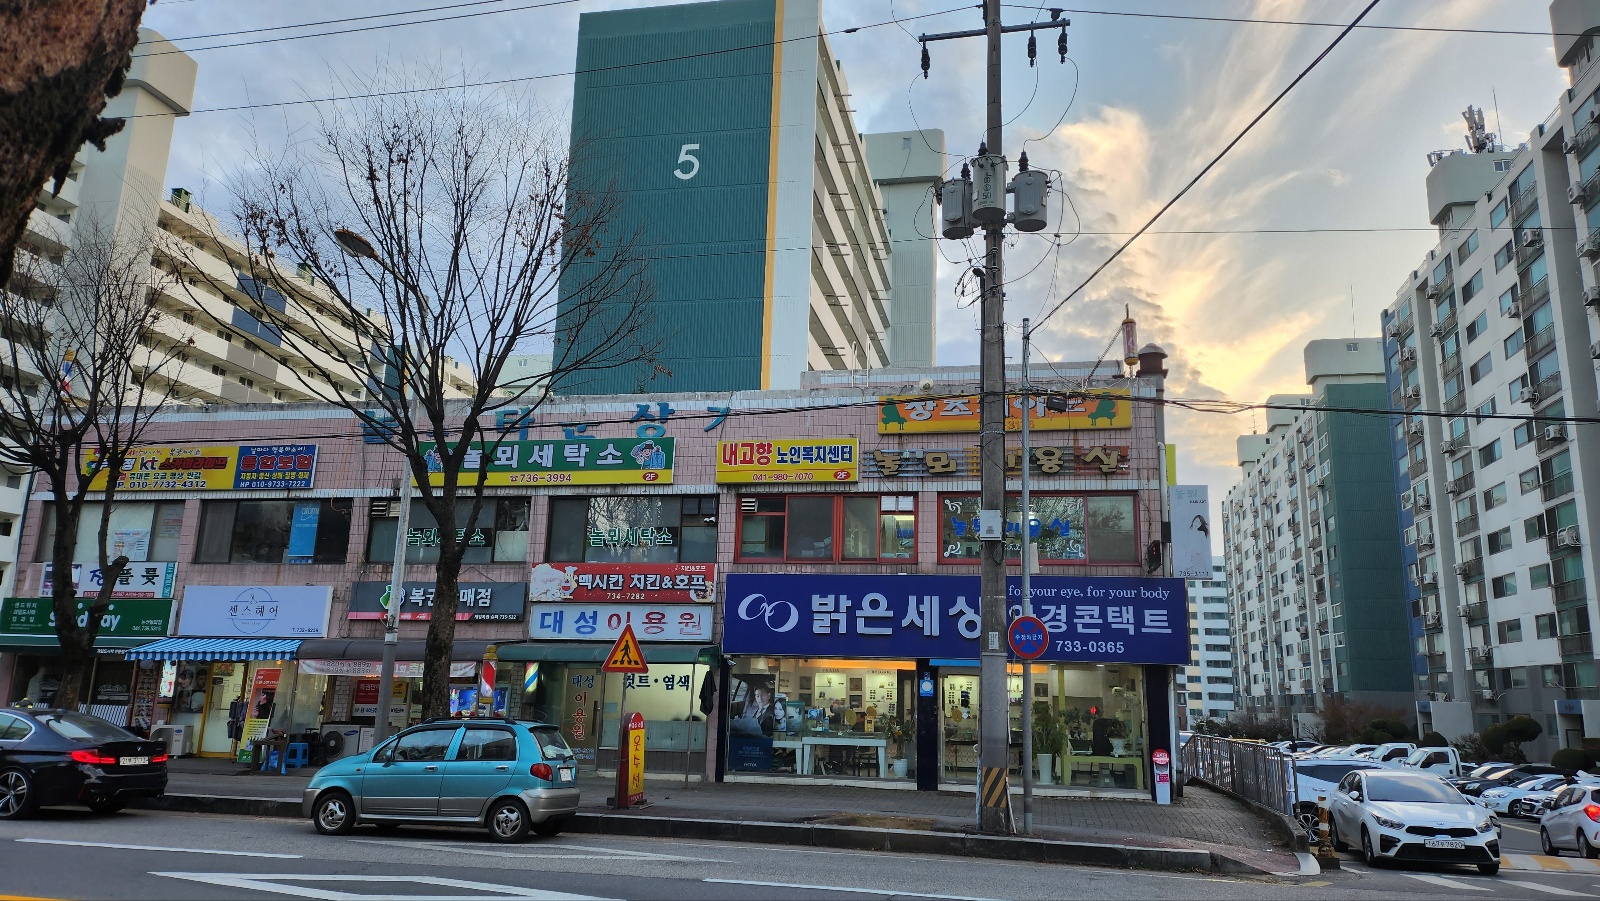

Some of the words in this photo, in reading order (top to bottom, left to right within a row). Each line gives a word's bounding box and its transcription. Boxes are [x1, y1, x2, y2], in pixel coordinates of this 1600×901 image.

[673, 143, 700, 180] 5
[463, 443, 624, 469] 놀뫼세탁소
[723, 442, 773, 465] 내고향
[777, 445, 853, 464] 노인복지센터
[140, 457, 158, 471] kt
[159, 457, 228, 470] 스카이라이프
[240, 454, 313, 471] 종합보험
[519, 474, 572, 483] 736-3994
[645, 473, 656, 481] 2F
[752, 473, 814, 481] 041-980-7070
[836, 471, 848, 480] 2F
[129, 481, 206, 489] 010-7732-4312
[589, 527, 673, 546] 놀뫼세탁소
[578, 573, 624, 590] 멕시칸
[630, 574, 706, 590] 치킨&호프
[607, 592, 645, 600] 734-7282
[1009, 585, 1026, 597] fo
[1029, 586, 1057, 598] your
[1087, 585, 1106, 597] for
[1108, 588, 1137, 598] your
[1139, 586, 1170, 600] body
[229, 604, 279, 617] 센스헤어
[540, 610, 702, 636] 대성이용원
[1055, 640, 1125, 653] 733-0365
[571, 674, 595, 689] 대성
[571, 691, 587, 741] 이용원
